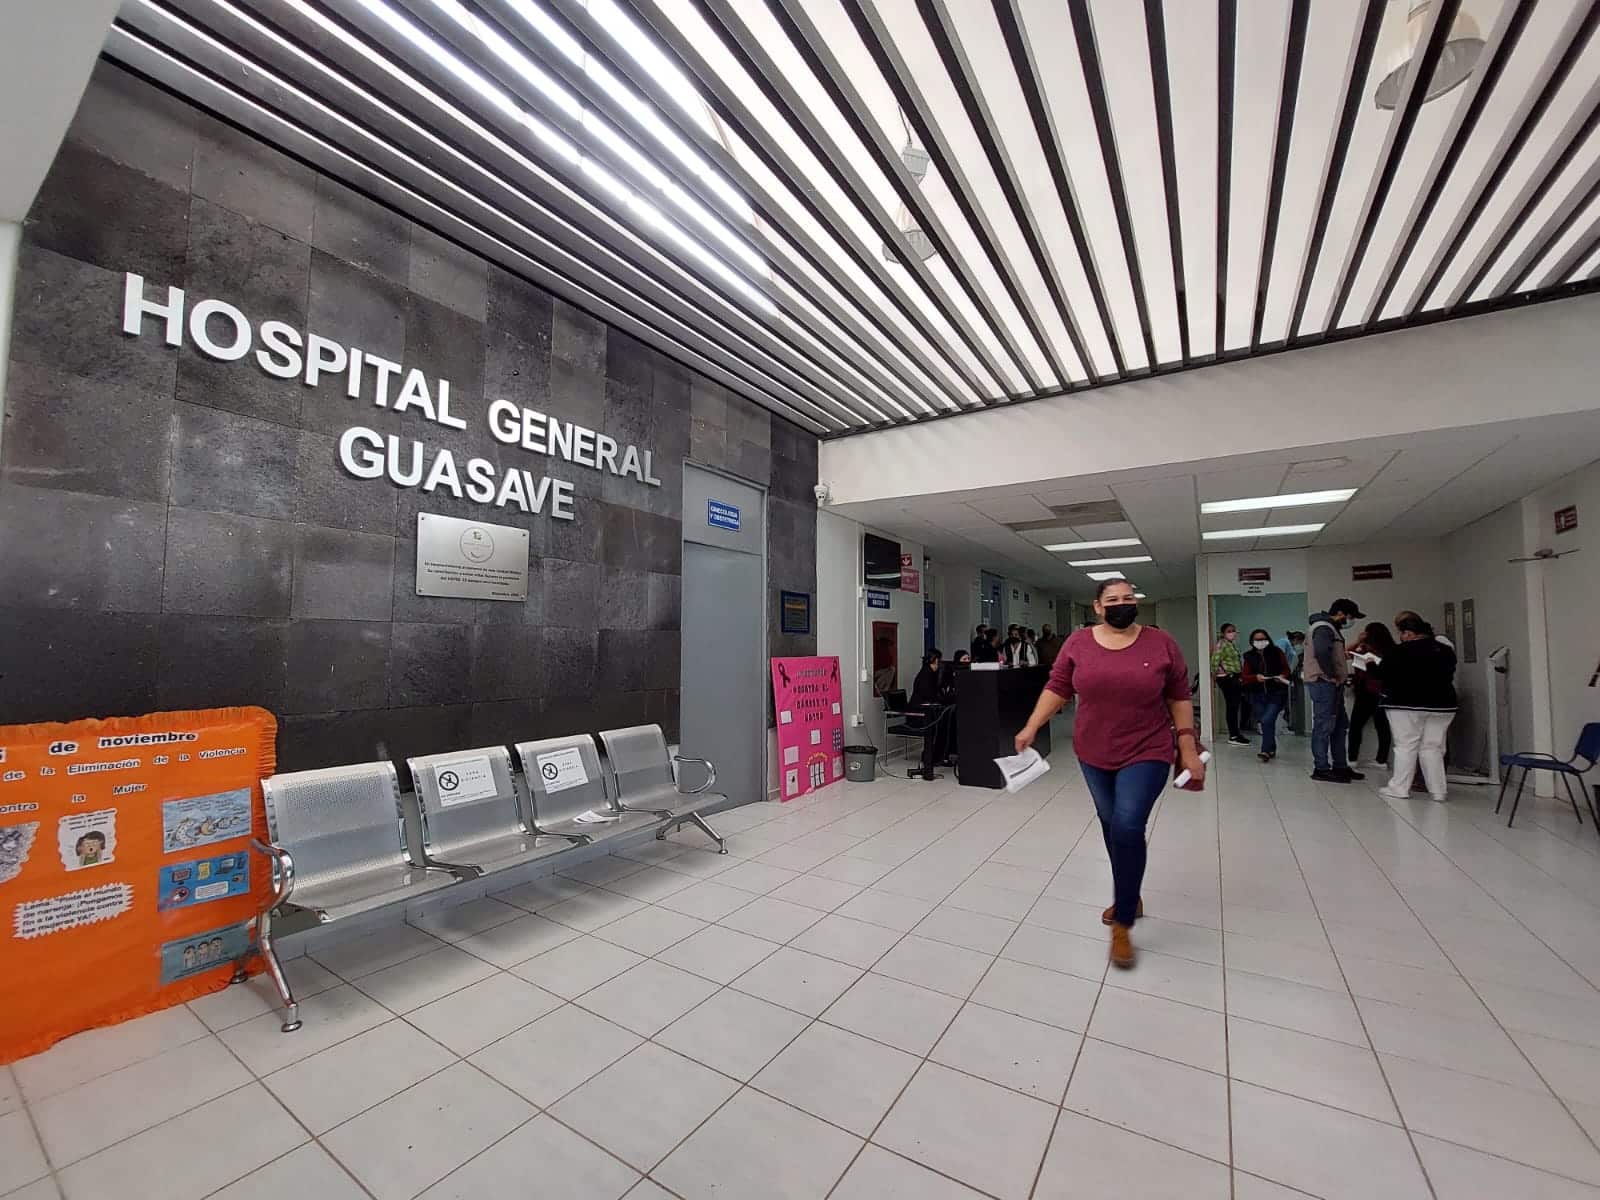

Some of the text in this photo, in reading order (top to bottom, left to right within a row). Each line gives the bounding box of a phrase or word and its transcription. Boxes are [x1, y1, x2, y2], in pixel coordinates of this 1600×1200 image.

[122, 271, 661, 487] HOSPITAL GENERAL
[339, 426, 576, 521] GUASAVE
[50, 732, 197, 754] de noviembre
[4, 747, 246, 780] de la Eliminación de la Violencia
[0, 784, 145, 813] ontra la Mujer
